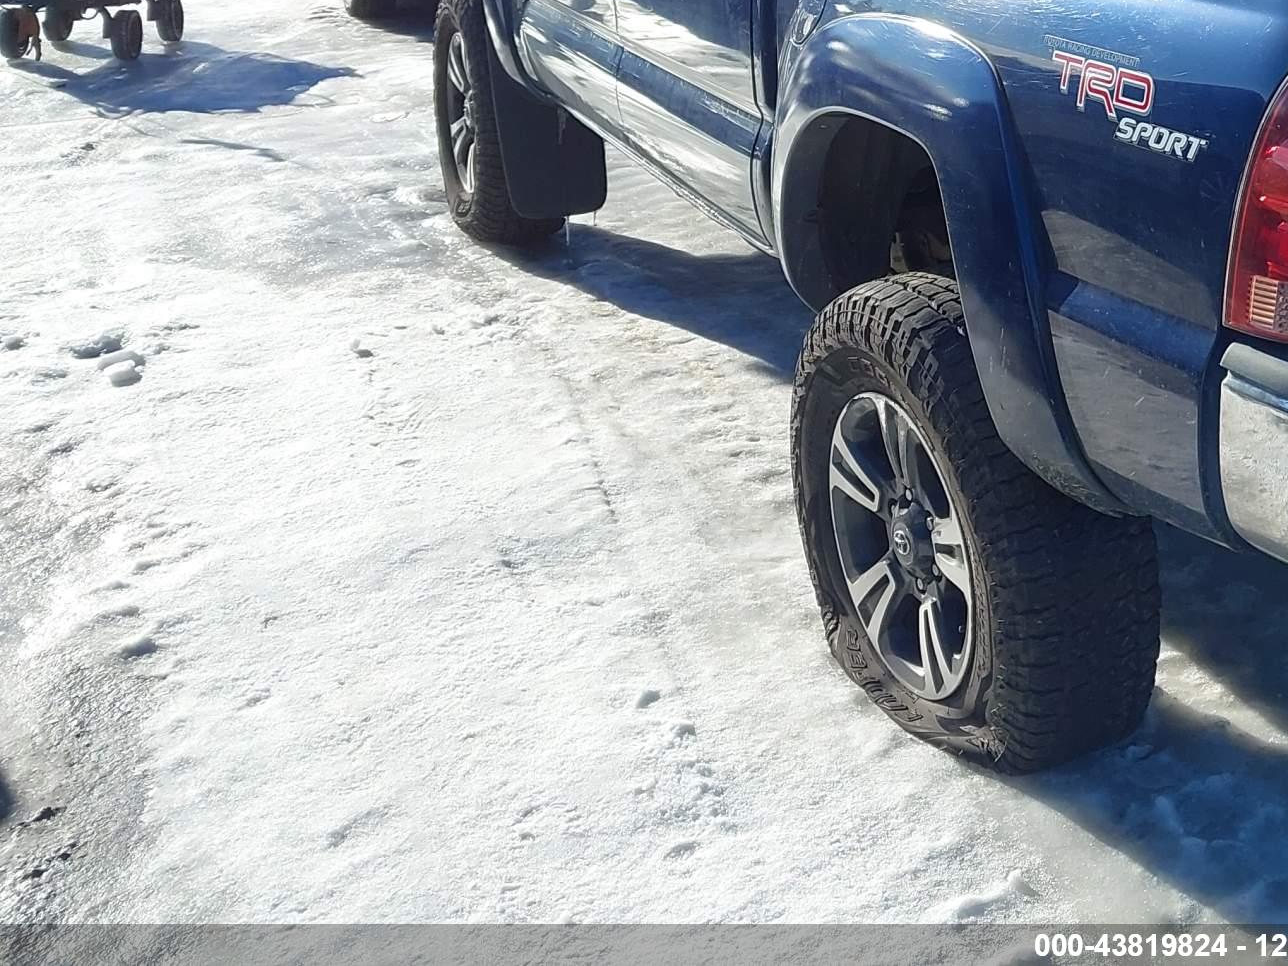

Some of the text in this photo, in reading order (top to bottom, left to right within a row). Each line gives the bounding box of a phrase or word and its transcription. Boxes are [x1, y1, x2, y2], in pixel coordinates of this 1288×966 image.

[1067, 41, 1091, 55] RACING
[1091, 47, 1140, 68] DEVELOPMENT
[1052, 50, 1155, 121] TRD
[1114, 117, 1204, 163] SPORT
